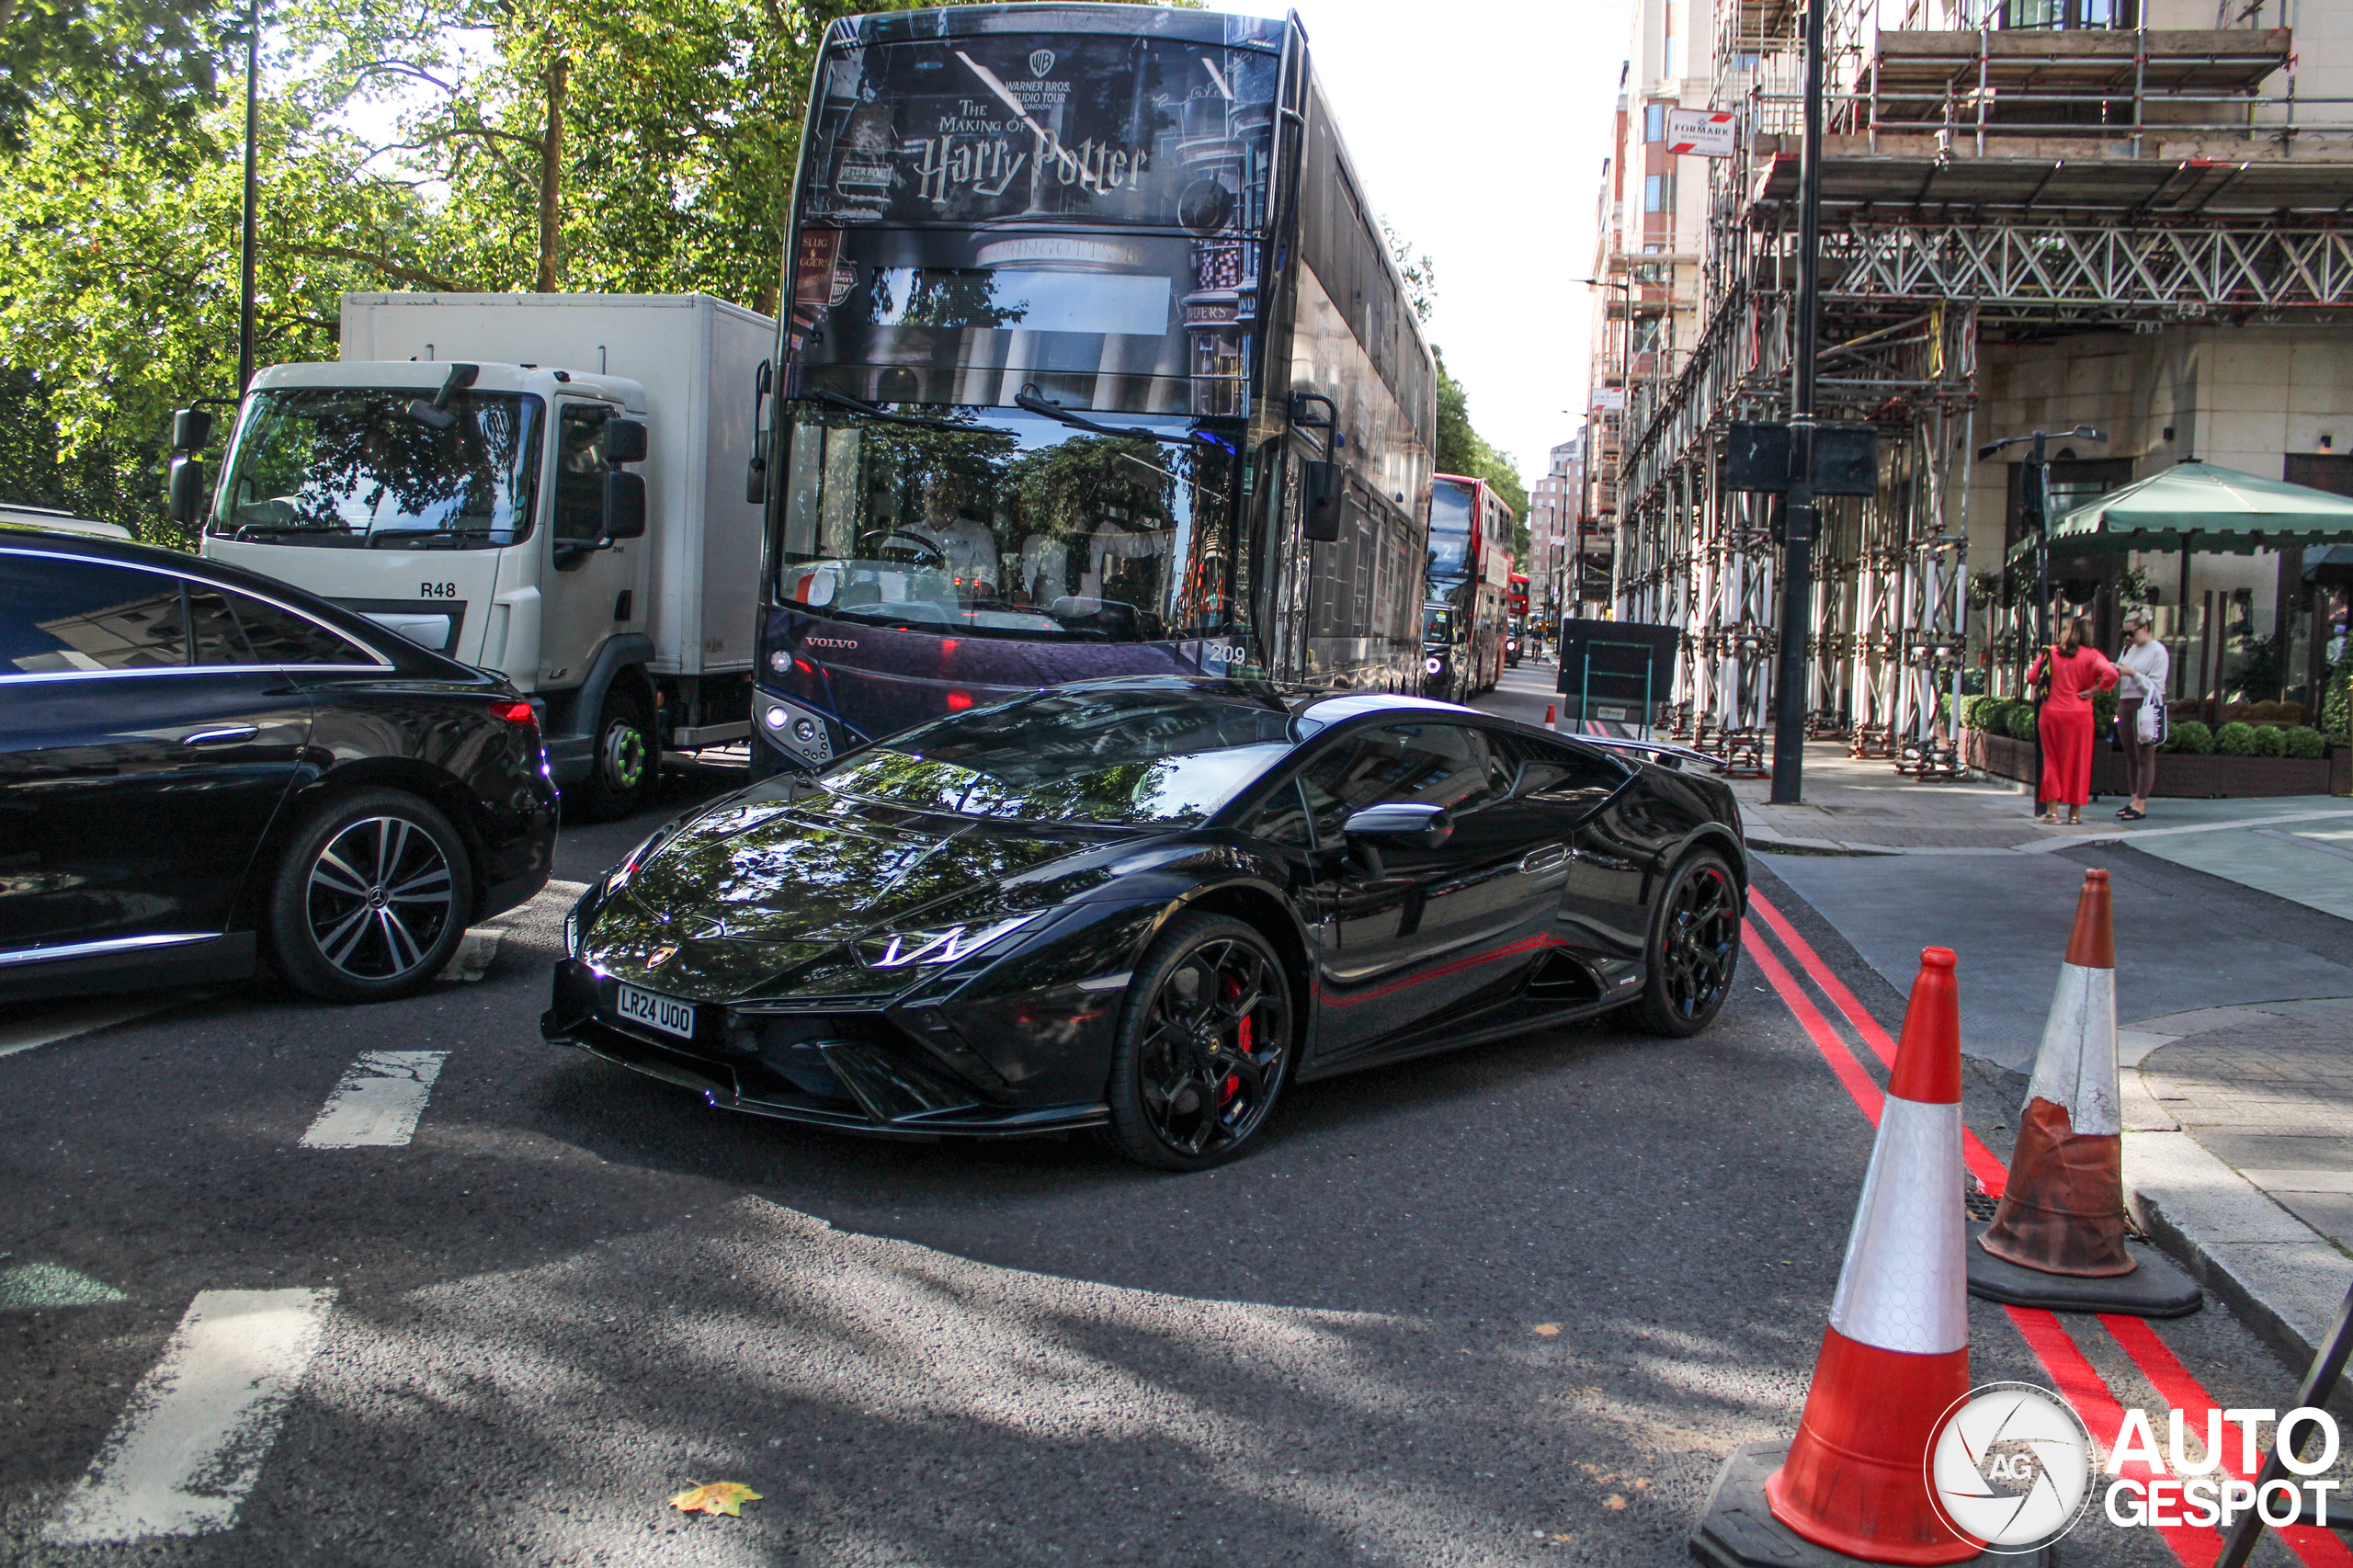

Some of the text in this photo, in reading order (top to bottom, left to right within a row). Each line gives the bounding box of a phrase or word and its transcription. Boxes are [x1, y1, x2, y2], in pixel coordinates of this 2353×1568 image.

[1006, 81, 1072, 92] WARNER BROS.
[1007, 92, 1066, 103] STUDIO TOUR
[938, 117, 1001, 133] MAKING
[1675, 123, 1729, 136] FORMARK
[914, 128, 1148, 206] Harry Potter
[802, 238, 827, 247] SLUG
[995, 240, 1112, 261] GRINGOTTS
[1443, 544, 1451, 559] 2
[421, 583, 456, 597] R48
[805, 637, 858, 649] VOLVO
[1210, 644, 1245, 664] 209
[549, 668, 567, 679] LF
[621, 989, 656, 1021] LR24
